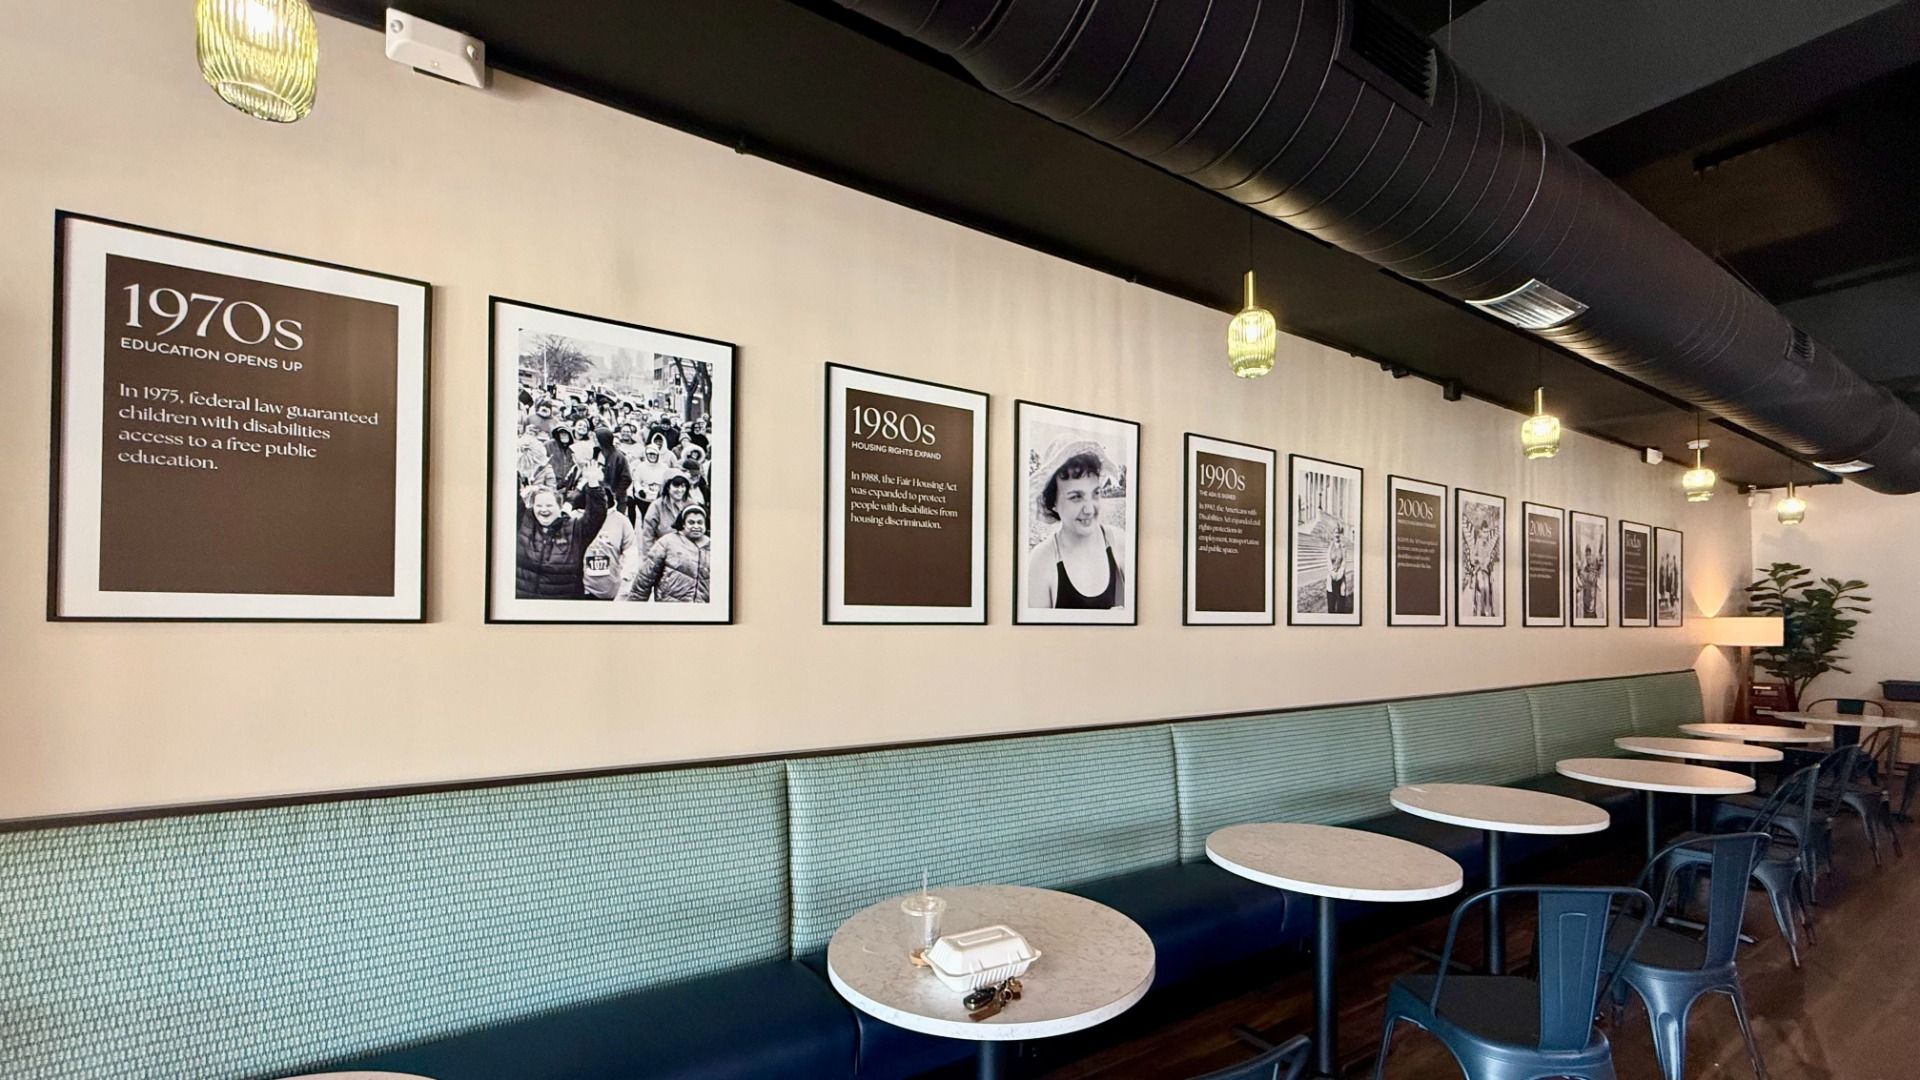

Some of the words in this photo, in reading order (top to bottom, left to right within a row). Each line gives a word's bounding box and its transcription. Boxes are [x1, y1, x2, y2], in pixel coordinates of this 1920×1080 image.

[123, 283, 304, 351] 1970s
[121, 337, 220, 360] EDUCATION
[225, 353, 278, 369] OPENS
[283, 360, 302, 371] UP
[120, 383, 138, 398] In
[144, 386, 184, 404] 1975,
[190, 392, 250, 411] federal
[255, 398, 283, 414] law
[287, 405, 379, 425] guaranteed
[118, 406, 196, 426] children
[201, 416, 238, 430] with
[243, 418, 330, 439] disabilities
[852, 405, 936, 445] 1980s
[118, 429, 183, 446] access
[188, 435, 207, 448] to
[211, 439, 222, 450] a
[227, 439, 261, 453] free
[265, 443, 317, 458] public
[852, 441, 887, 452] HOUSING
[888, 446, 913, 456] RIGHTS
[914, 450, 941, 460] EXPAND
[118, 450, 218, 469] education.
[851, 471, 859, 480] In
[862, 473, 880, 483] 1988,
[882, 475, 895, 484] the
[897, 476, 911, 486] Fair
[912, 478, 944, 492] Housing
[944, 482, 957, 491] Act
[1200, 464, 1245, 491] 1990s
[868, 489, 907, 499] expanded
[918, 493, 946, 503] protect
[850, 513, 883, 526] housing
[885, 517, 942, 529] discrimination.
[851, 502, 880, 512] people
[881, 502, 897, 512] with
[899, 503, 938, 516] disabilities
[940, 507, 958, 517] from
[1398, 498, 1433, 520] 2000s
